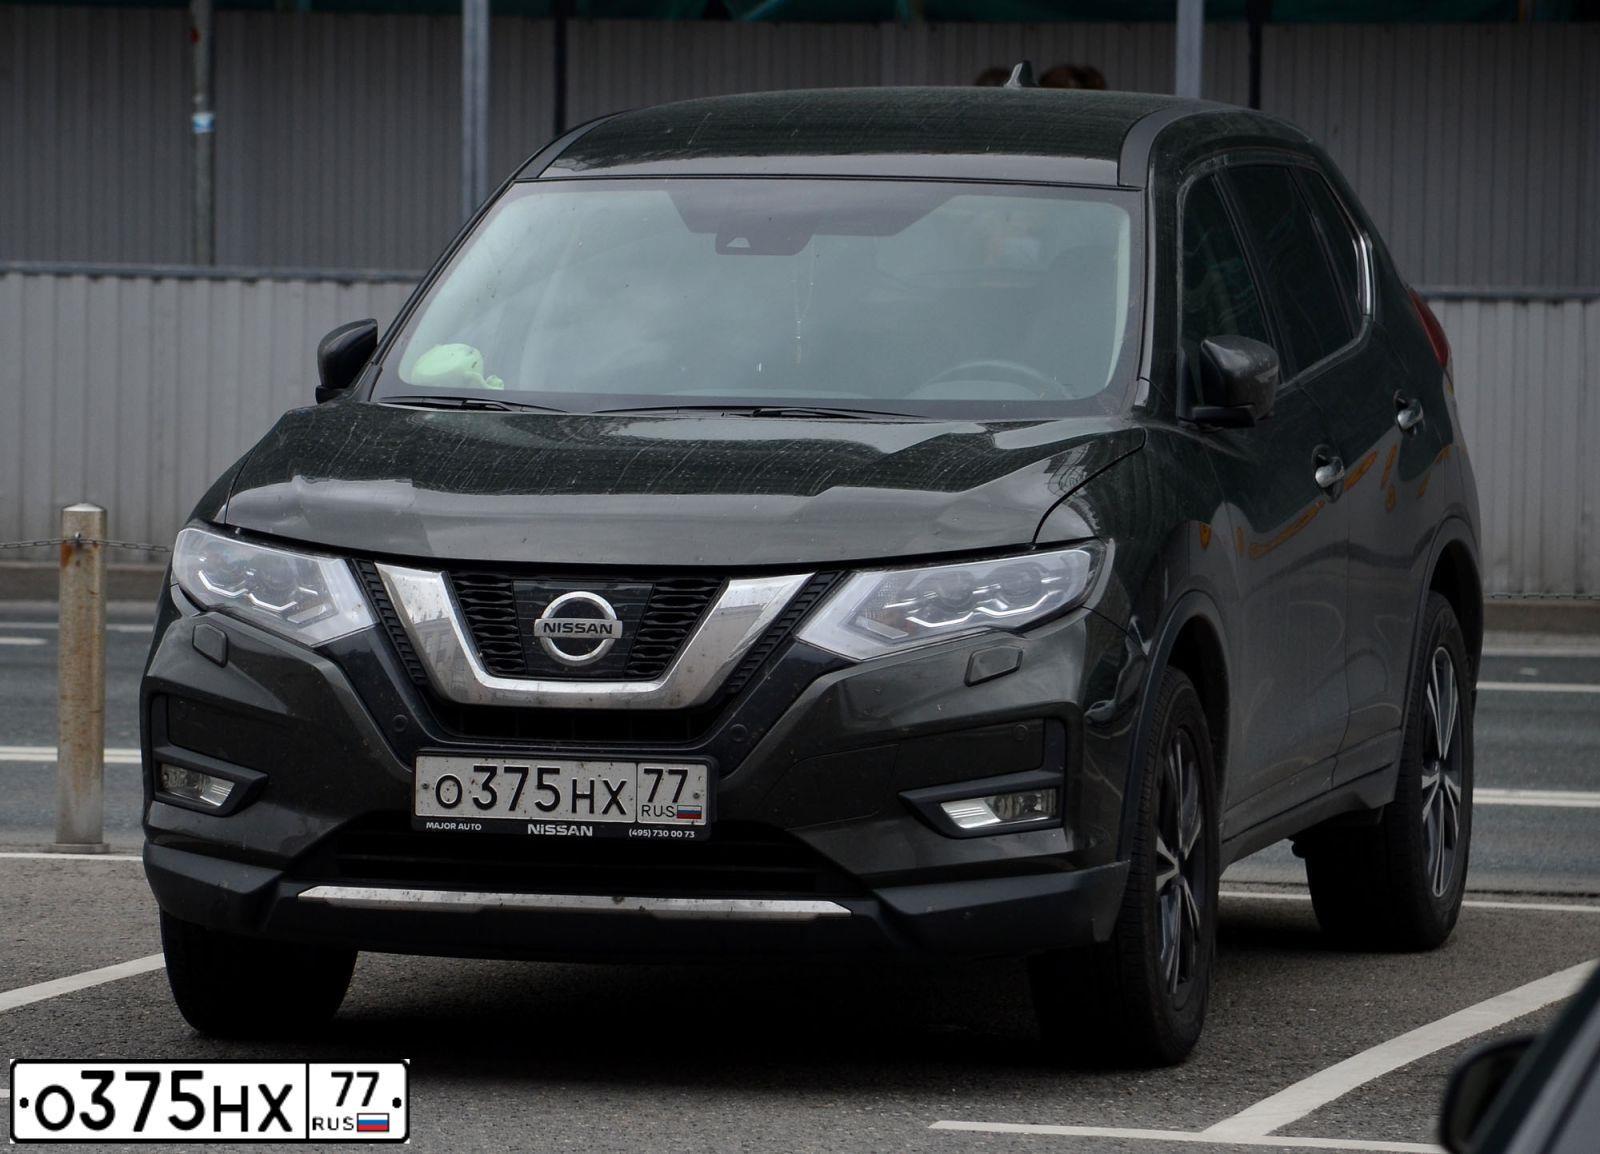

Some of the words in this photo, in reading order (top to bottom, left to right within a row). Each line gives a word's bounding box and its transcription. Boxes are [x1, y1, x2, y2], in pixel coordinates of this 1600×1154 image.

[543, 622, 613, 634] NISSAN
[643, 768, 688, 803] 77
[641, 804, 675, 818] RUS
[426, 822, 456, 830] MAJOR
[457, 822, 482, 831] AUTO
[528, 824, 593, 837] NISSAN
[629, 828, 651, 837] (495)
[652, 828, 669, 837] 730
[671, 828, 683, 838] 00
[684, 829, 695, 838] 73
